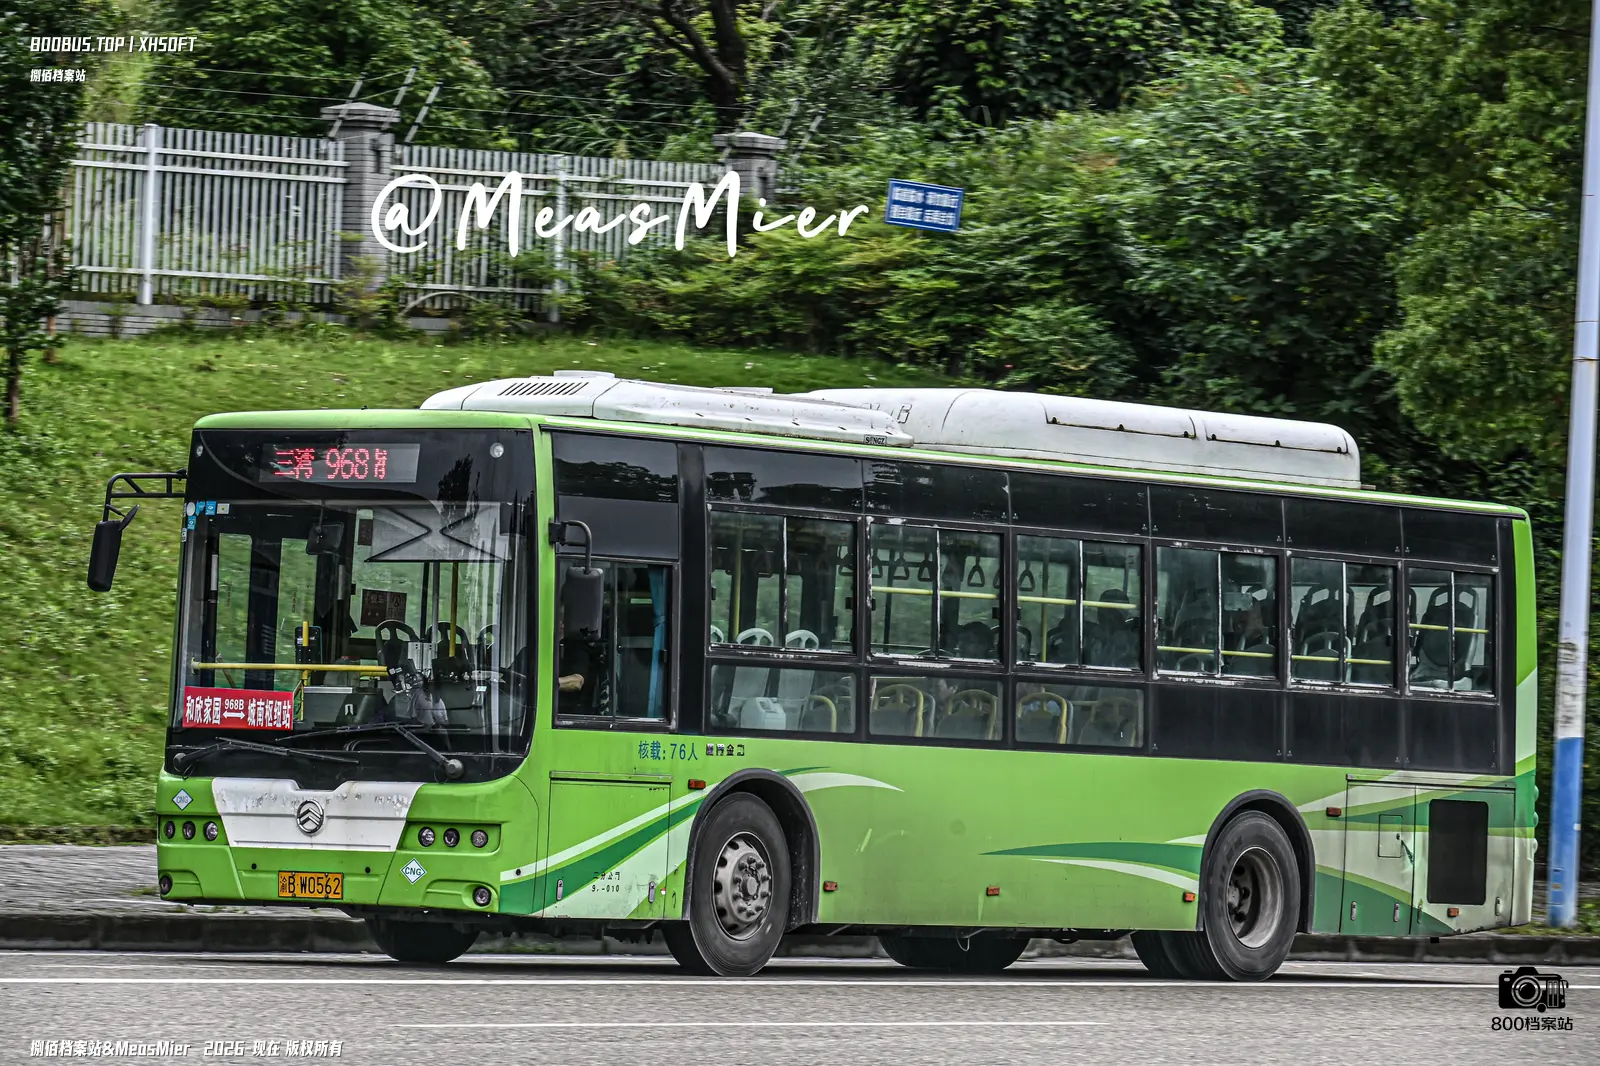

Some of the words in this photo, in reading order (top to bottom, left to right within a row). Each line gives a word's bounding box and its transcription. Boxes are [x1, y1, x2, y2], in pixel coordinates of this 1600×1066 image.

[325, 448, 370, 479] 968
[186, 695, 222, 725] 和欣家园
[224, 698, 244, 710] 968B
[247, 699, 291, 728] 城南枢纽站
[176, 796, 188, 804] CNG
[404, 867, 421, 876] CNG
